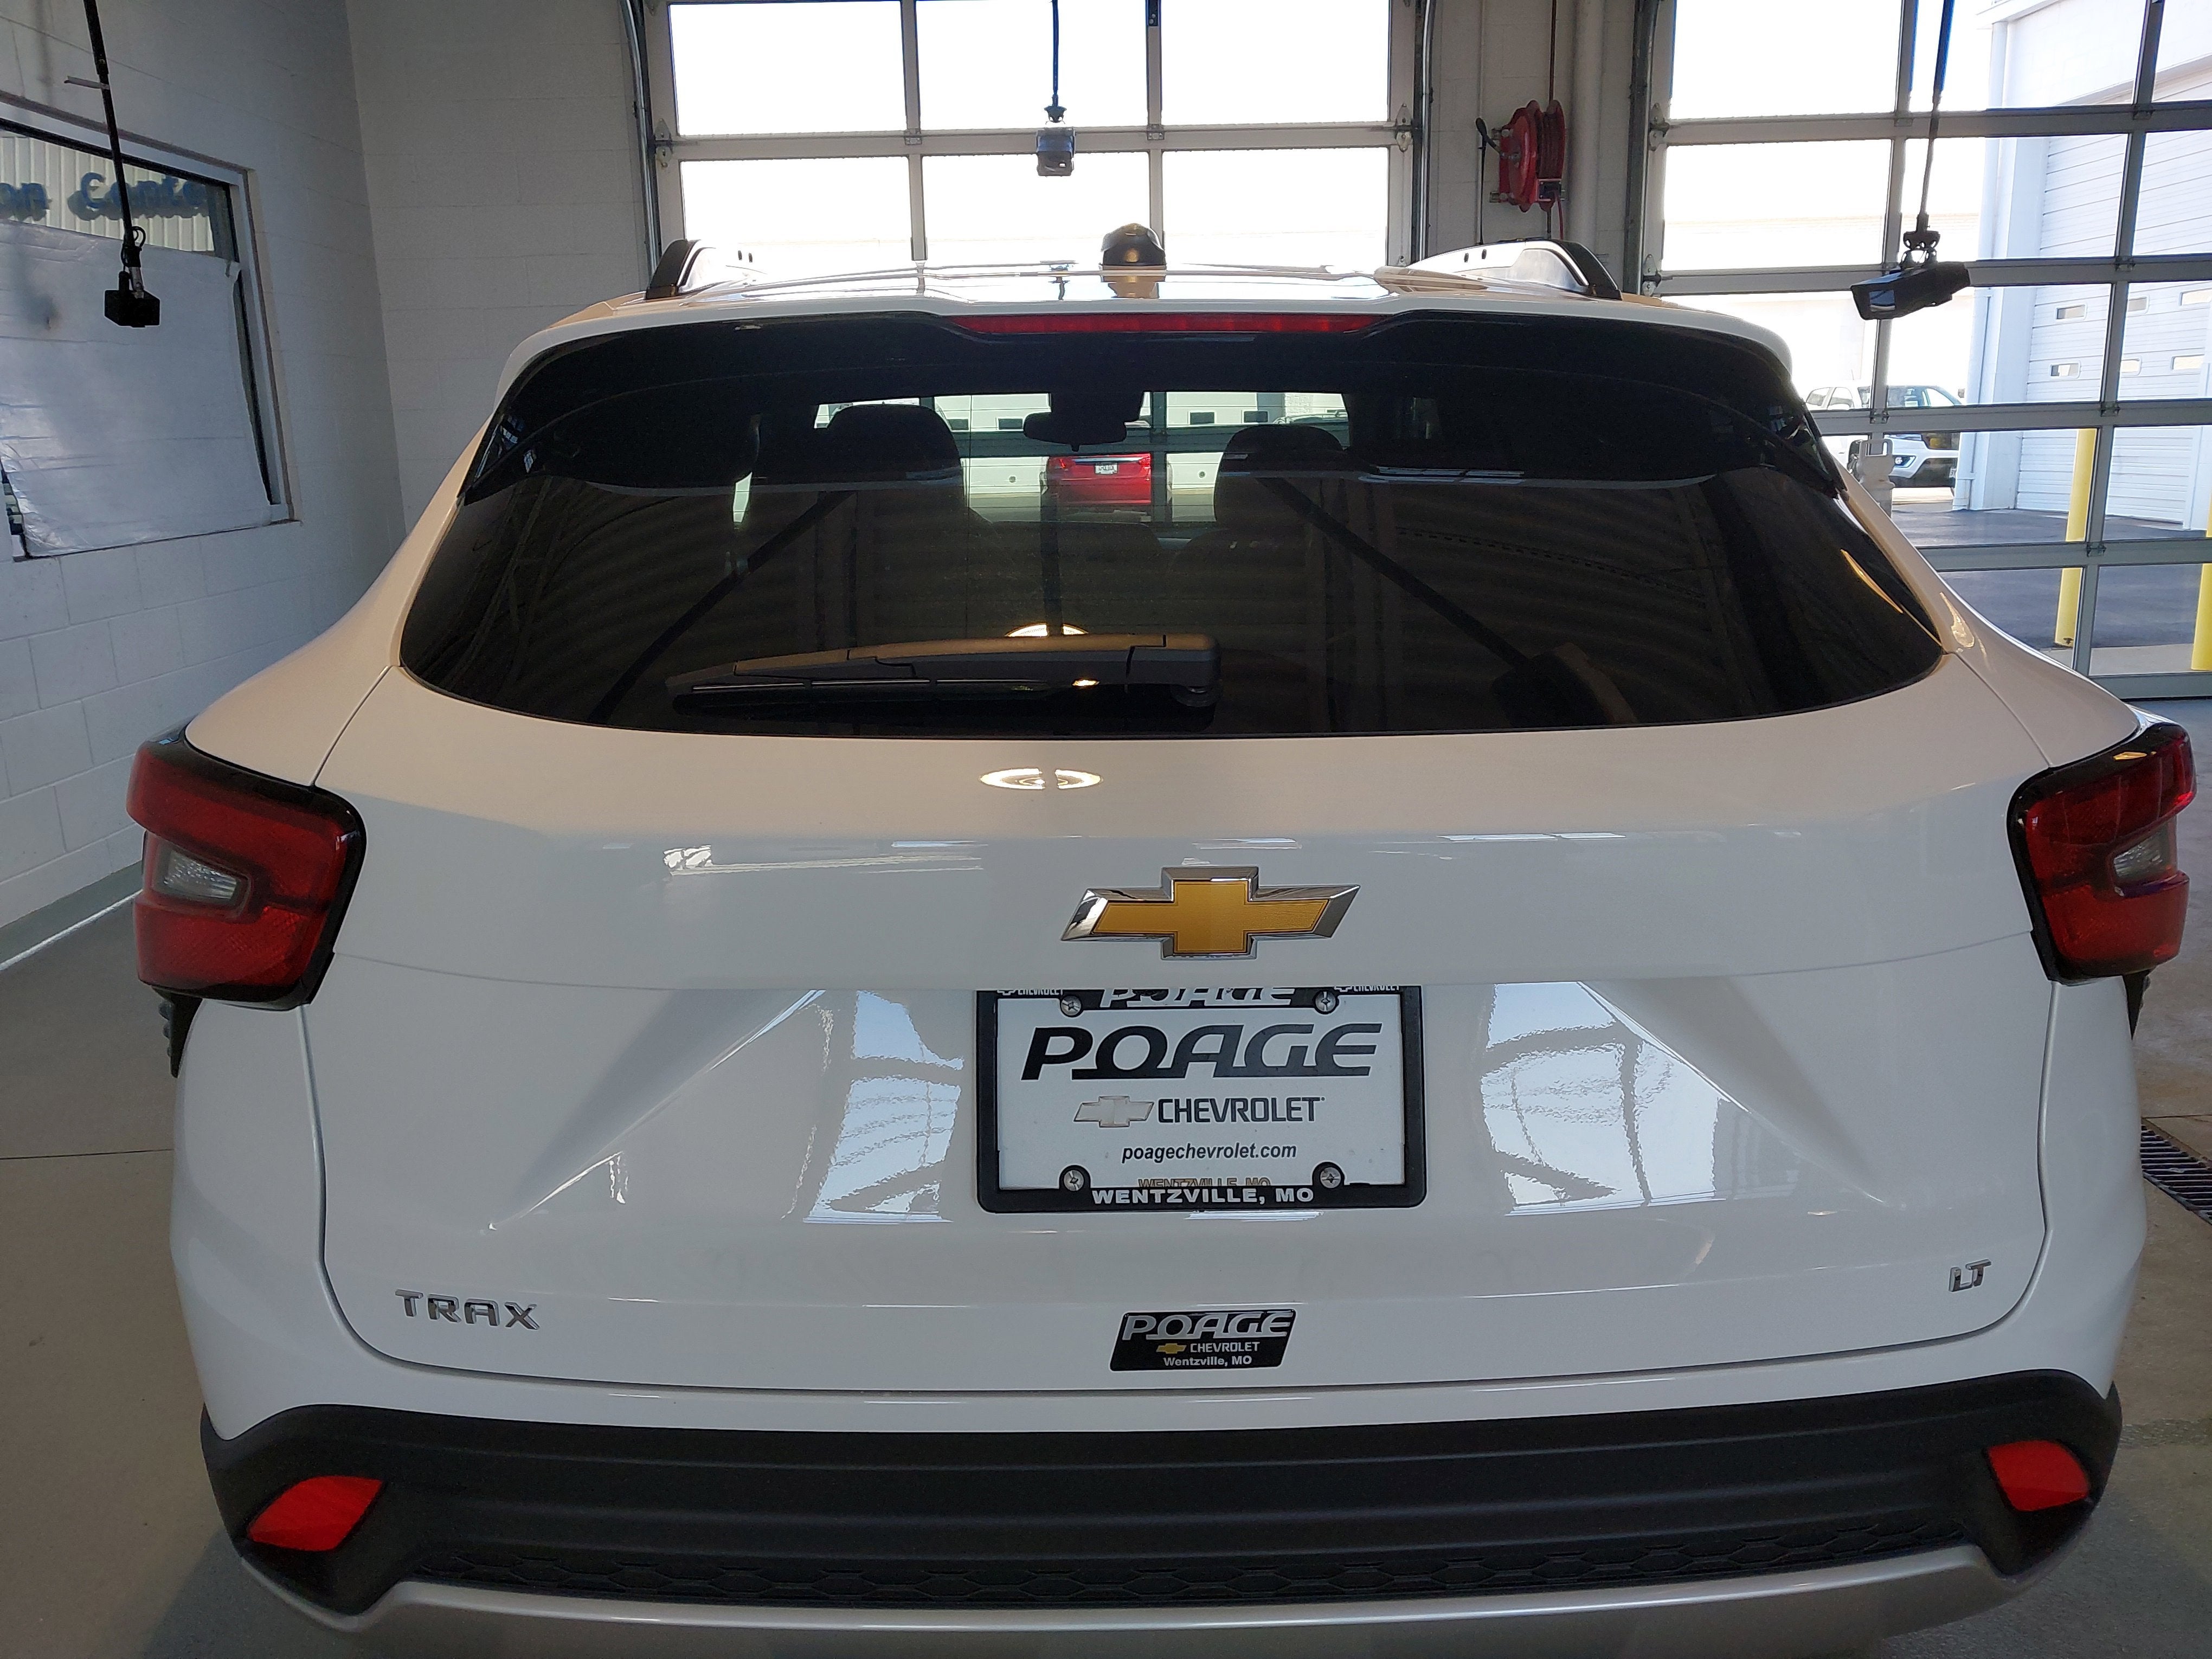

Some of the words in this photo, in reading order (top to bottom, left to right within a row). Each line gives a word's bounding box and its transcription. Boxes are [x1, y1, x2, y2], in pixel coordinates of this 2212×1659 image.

[1020, 1023, 1382, 1081] POAGE
[1158, 1097, 1321, 1123] CHEVROLET
[1122, 1142, 1297, 1163] poagechevrolet.com
[1091, 1188, 1265, 1205] WENTZVILLE,
[1275, 1187, 1314, 1203] MO
[1949, 1258, 1992, 1292] LT
[395, 1289, 540, 1330] TRAX
[1122, 1311, 1294, 1341] POAGE
[1189, 1341, 1261, 1353] CHEVROLET
[1163, 1356, 1228, 1367] Wentzville,
[1231, 1355, 1252, 1365] MO
